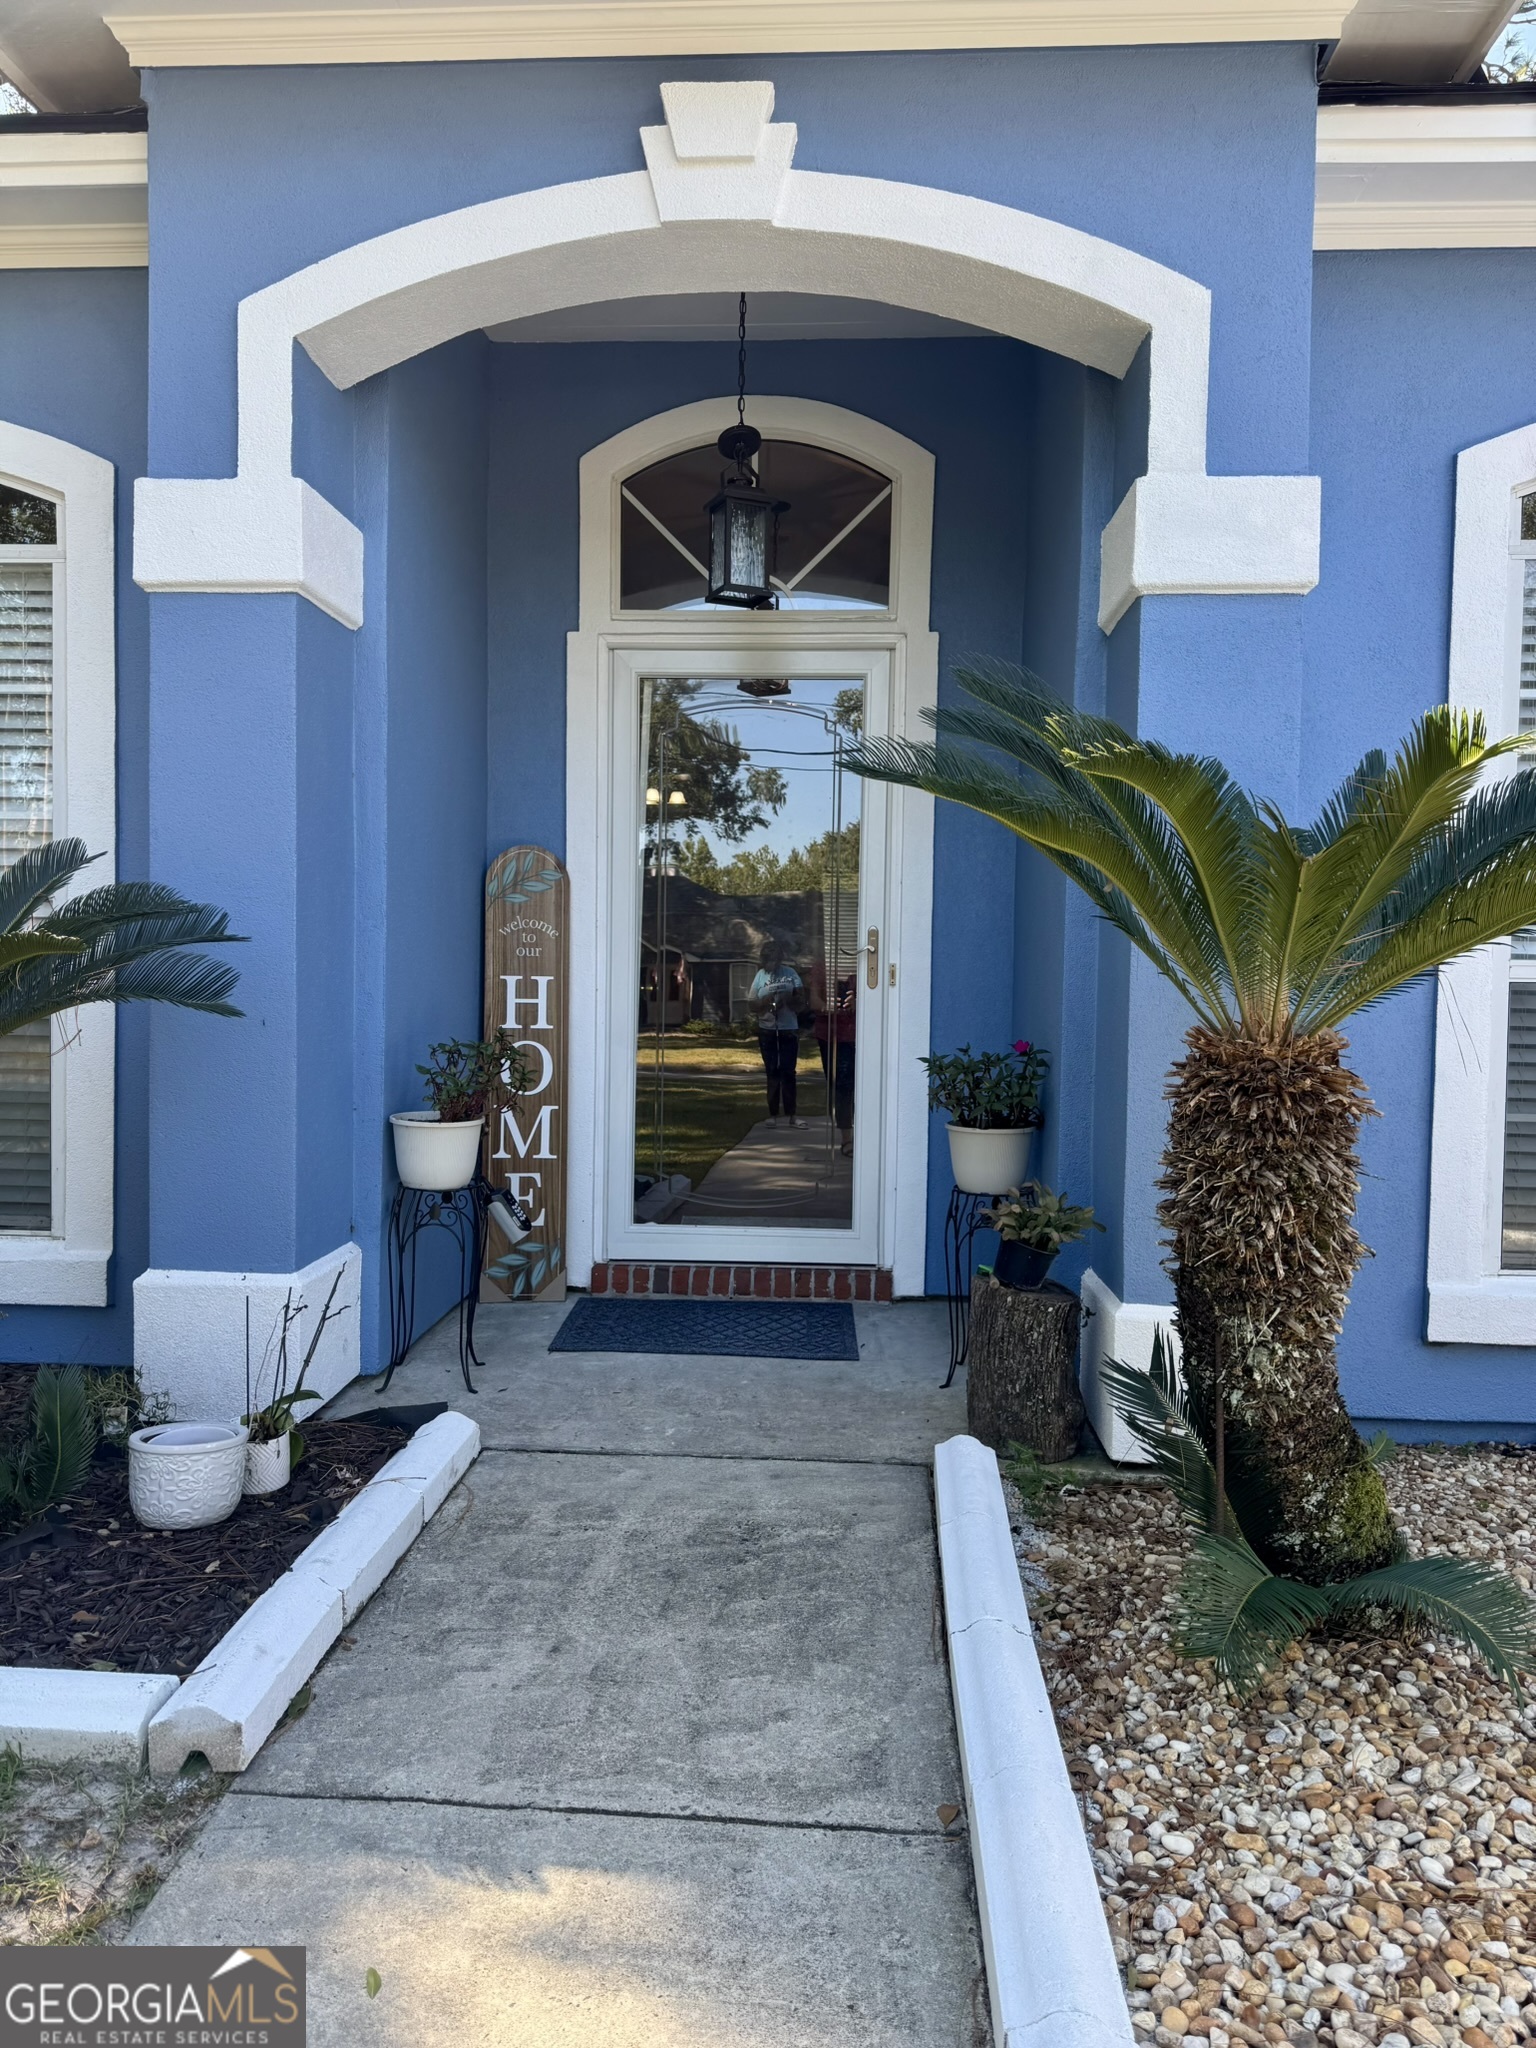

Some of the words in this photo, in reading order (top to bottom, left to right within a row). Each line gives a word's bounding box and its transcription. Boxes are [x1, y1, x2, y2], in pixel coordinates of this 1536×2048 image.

[498, 915, 560, 939] welcome
[522, 932, 537, 943] to
[516, 946, 543, 957] our
[492, 975, 559, 1227] HOME
